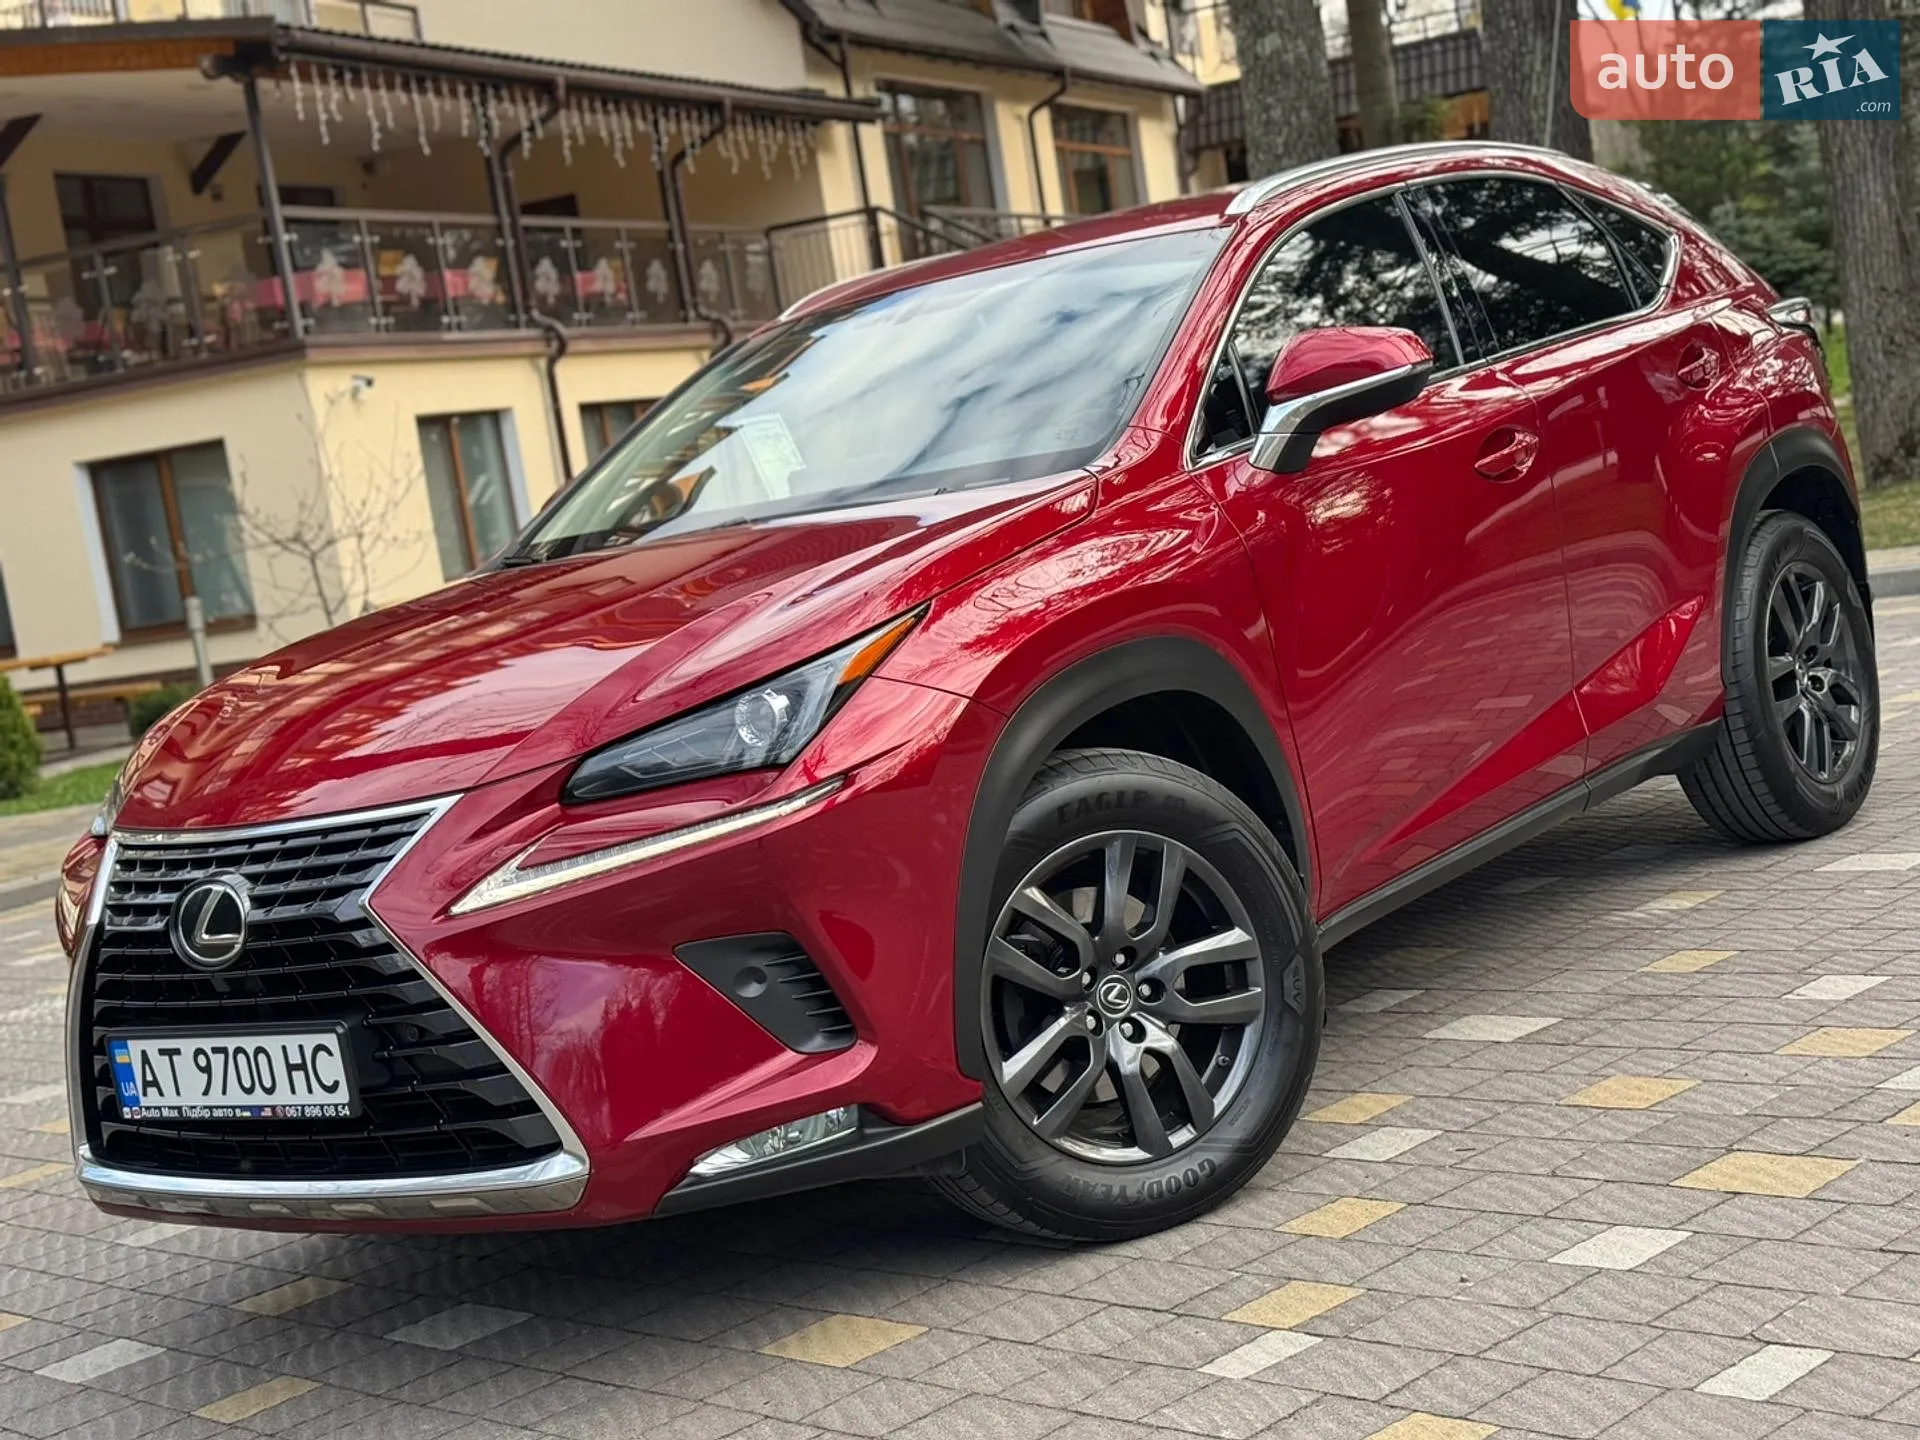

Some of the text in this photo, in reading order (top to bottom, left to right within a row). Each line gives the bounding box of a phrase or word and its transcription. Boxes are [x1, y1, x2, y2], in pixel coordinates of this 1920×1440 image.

[141, 1043, 340, 1097] AT 9700 HC
[121, 1081, 138, 1097] UA
[141, 1106, 160, 1118] Auto
[285, 1105, 302, 1117] 067
